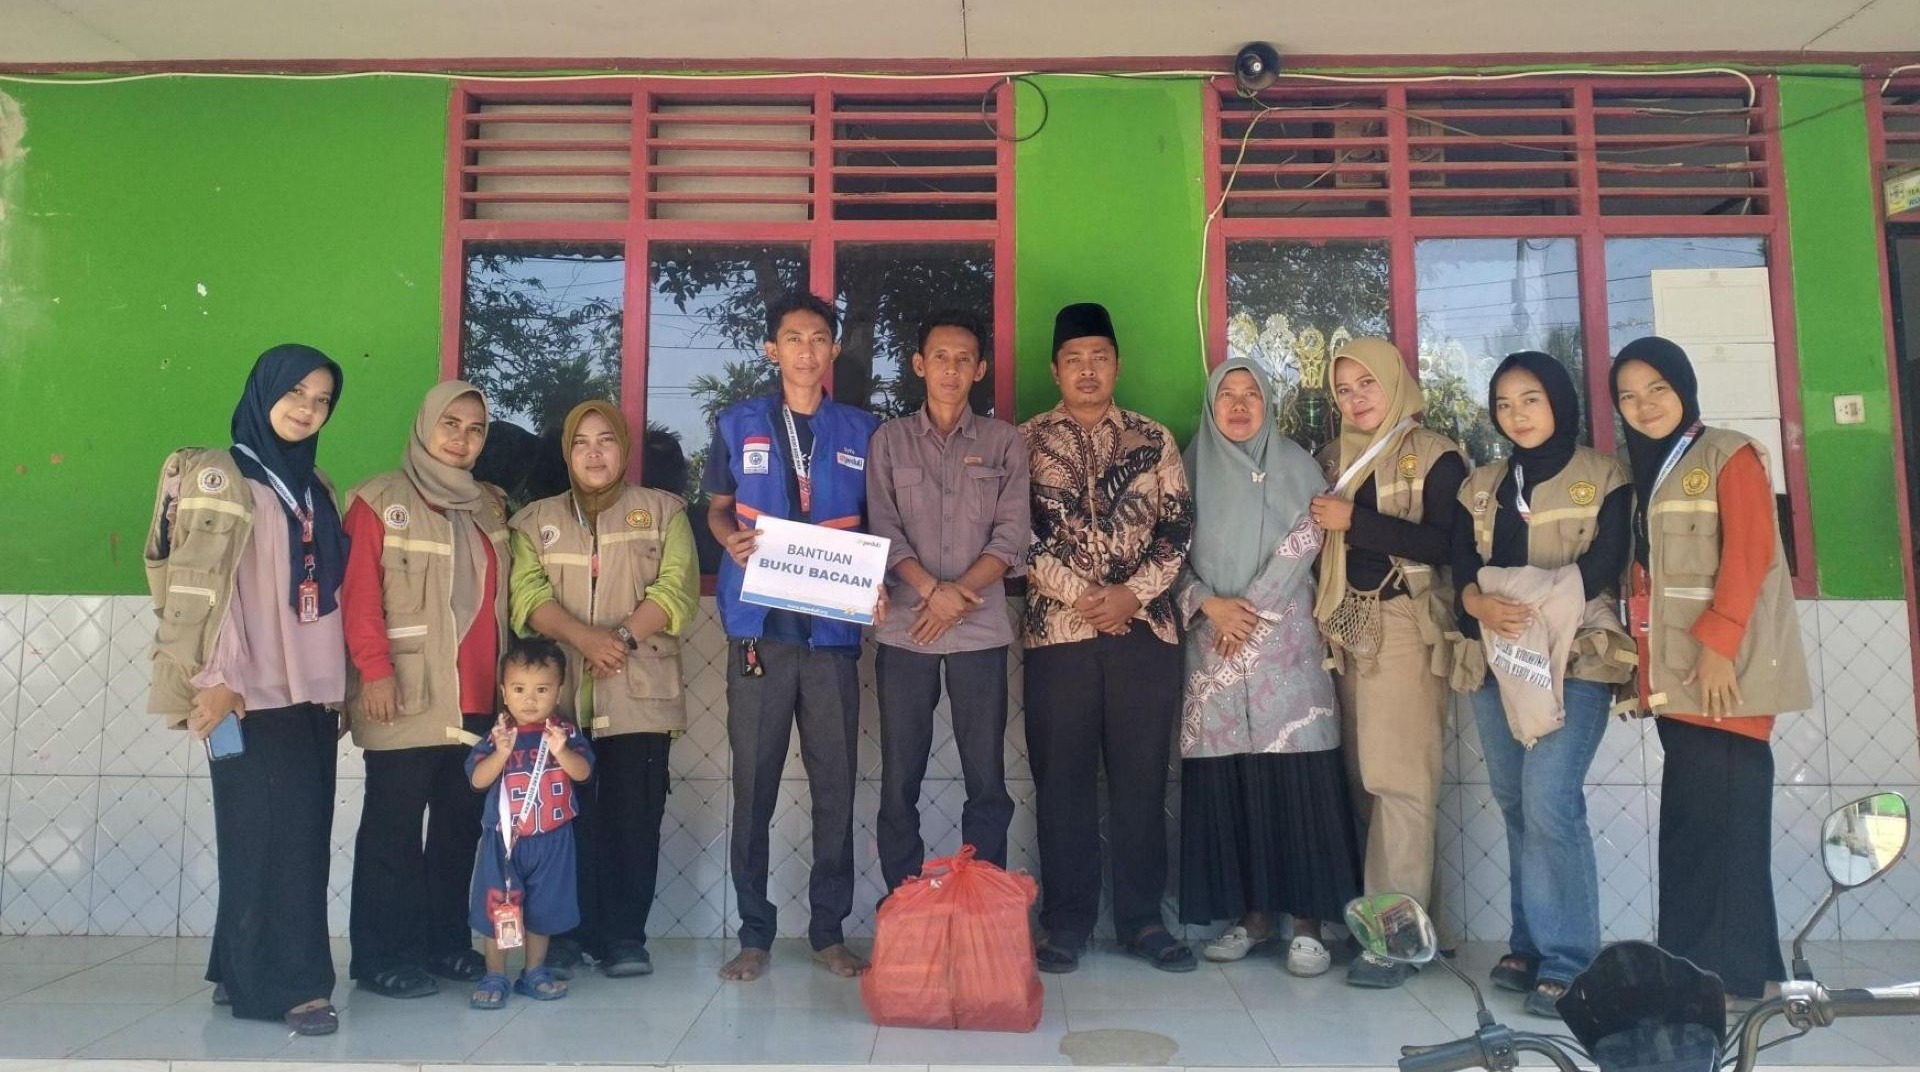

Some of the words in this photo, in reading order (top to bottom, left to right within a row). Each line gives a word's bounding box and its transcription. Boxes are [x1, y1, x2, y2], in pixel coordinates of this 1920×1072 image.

[787, 543, 853, 566] BANTUAN
[759, 557, 804, 575] BUKU
[808, 567, 873, 589] BACAAN
